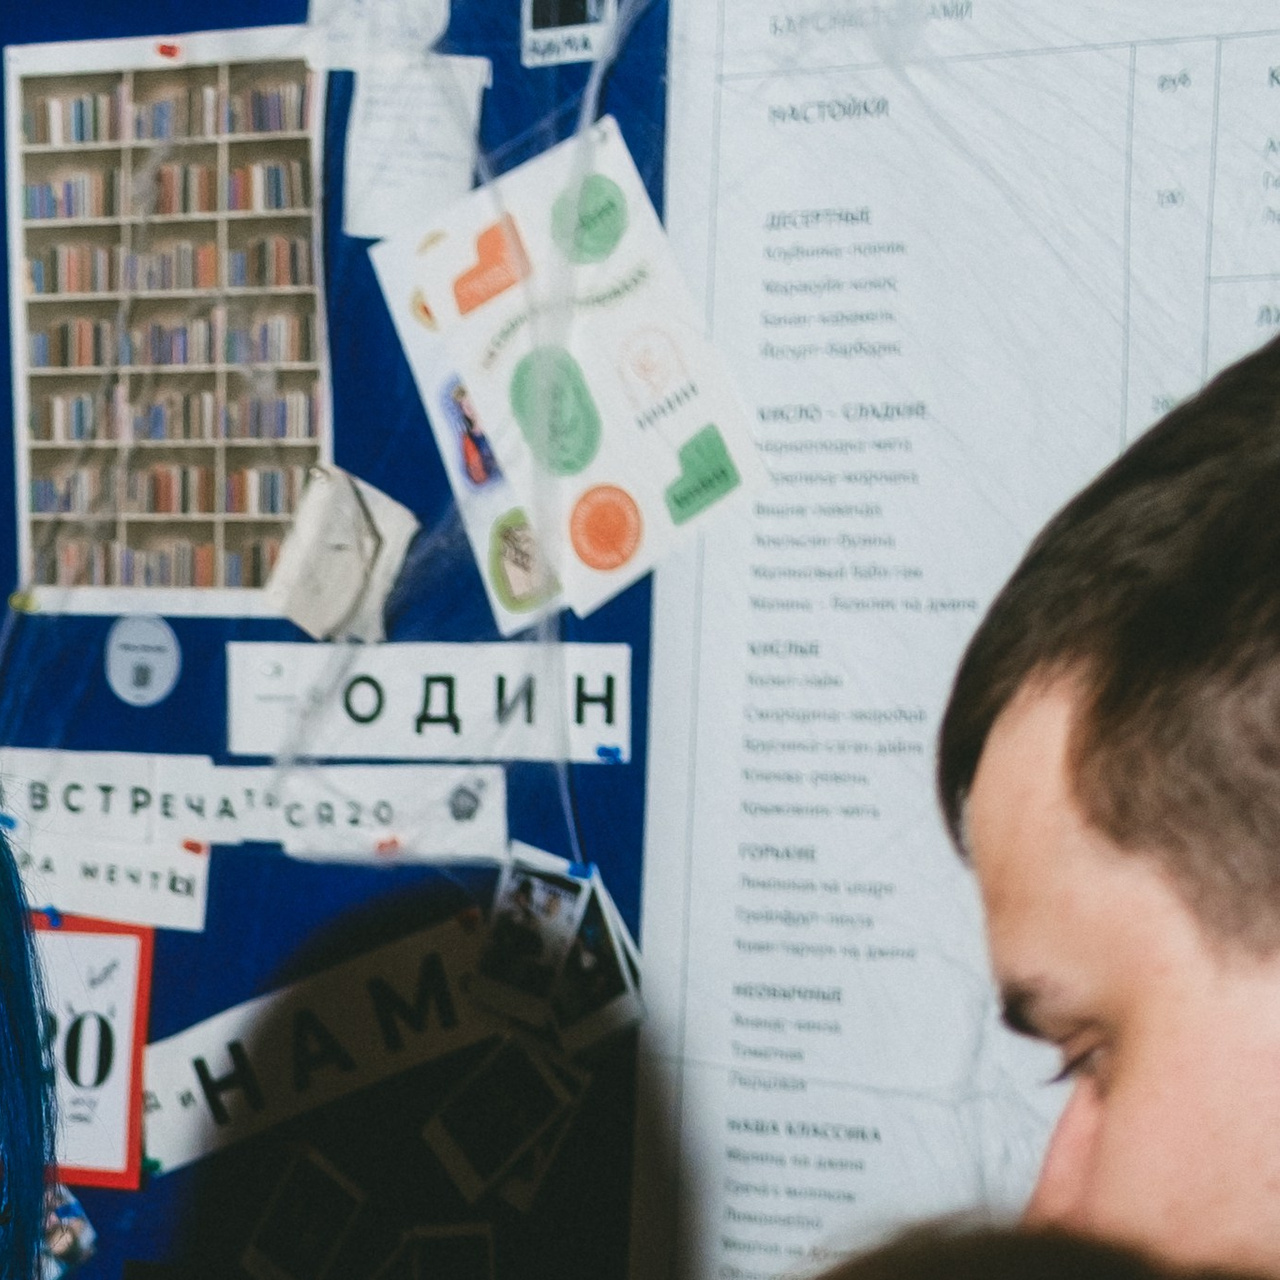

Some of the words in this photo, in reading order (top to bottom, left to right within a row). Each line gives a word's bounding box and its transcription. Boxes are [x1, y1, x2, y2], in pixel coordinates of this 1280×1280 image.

[767, 95, 890, 124] НАСТОЙКИ
[343, 672, 617, 736] ОДИН
[783, 1119, 883, 1144] КЛАССИКА
